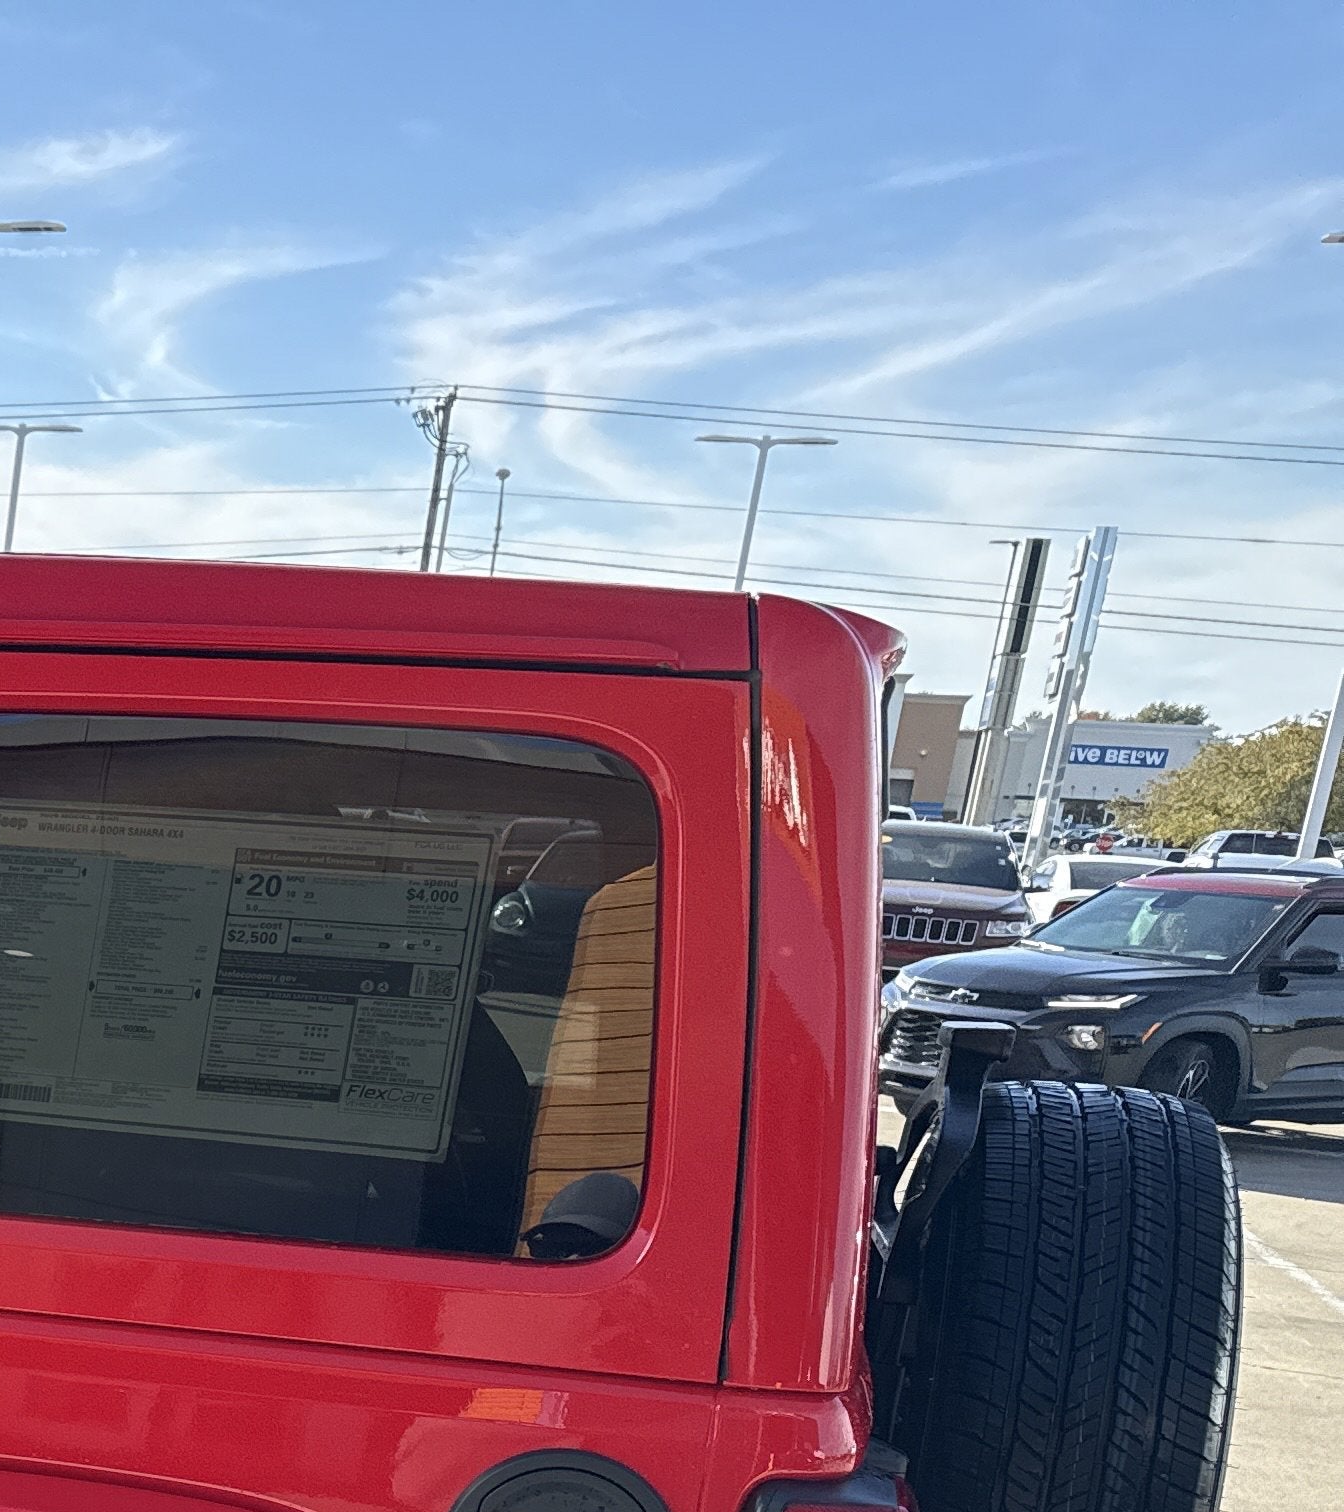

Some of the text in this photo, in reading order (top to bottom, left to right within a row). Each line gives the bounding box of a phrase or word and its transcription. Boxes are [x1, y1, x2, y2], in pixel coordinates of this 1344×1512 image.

[37, 822, 89, 834] WRANGLER
[127, 827, 165, 839] SAHARA
[246, 873, 283, 898] 20
[424, 878, 458, 889] spend
[406, 888, 459, 904] $4,000
[912, 906, 933, 915] Jeep
[260, 922, 283, 930] cost
[227, 929, 278, 945] $2,500
[346, 1084, 435, 1105] FlexCare
